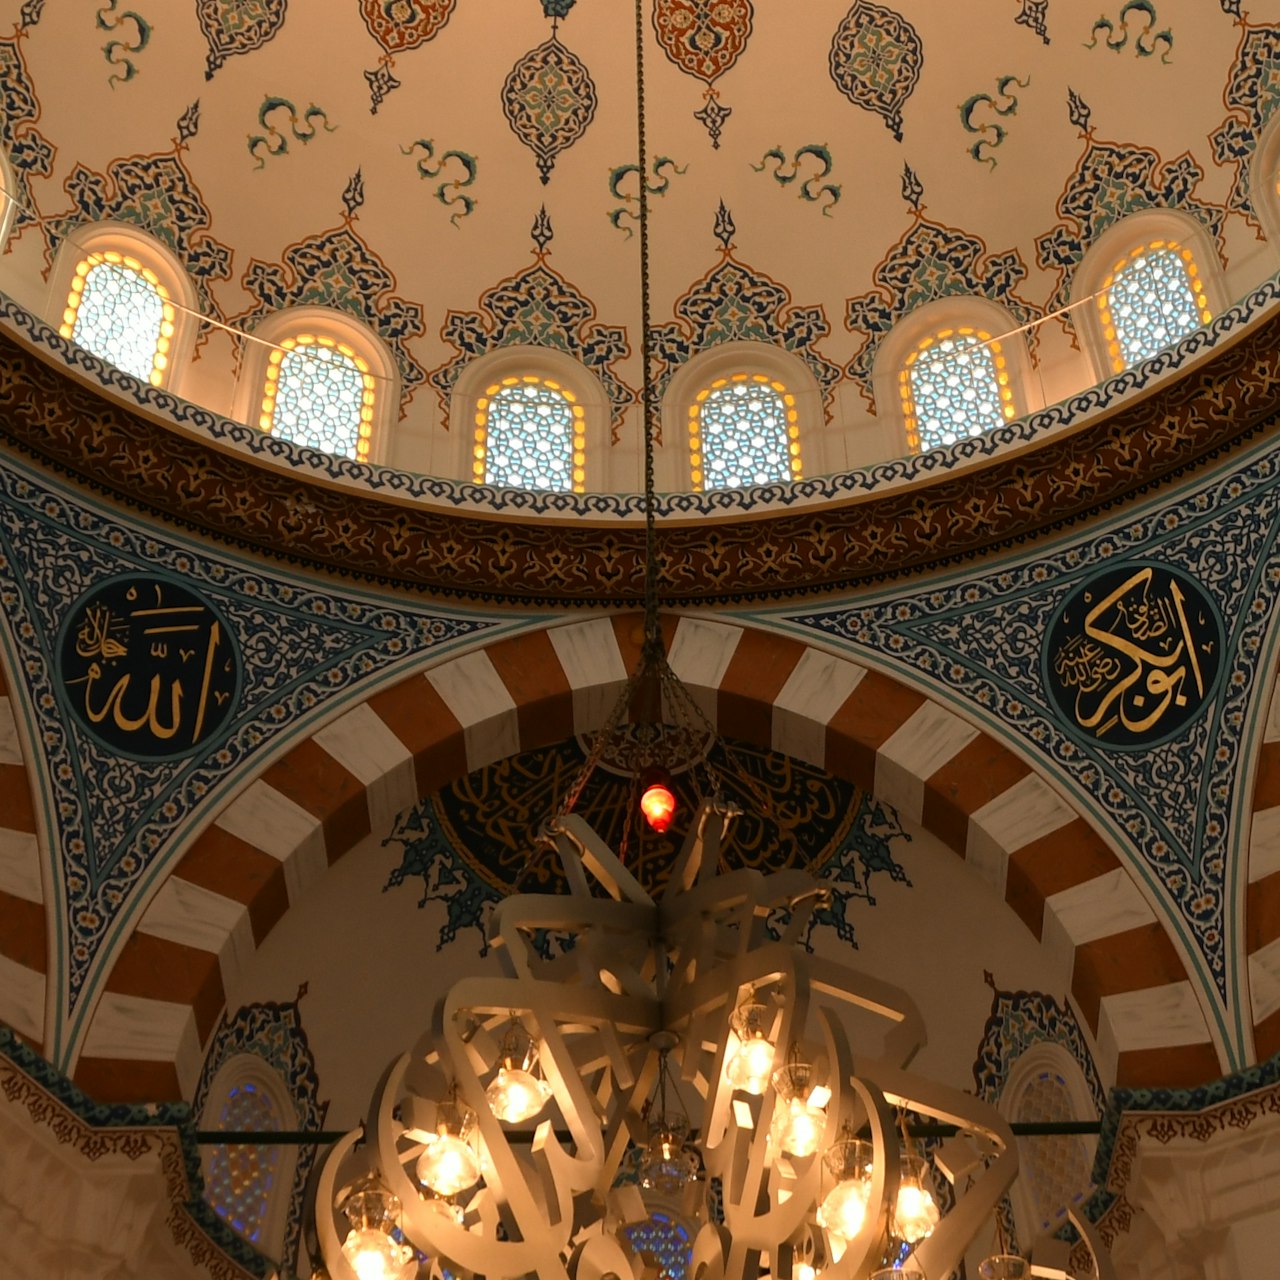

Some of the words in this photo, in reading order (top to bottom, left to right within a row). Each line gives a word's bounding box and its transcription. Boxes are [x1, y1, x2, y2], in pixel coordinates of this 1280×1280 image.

[84, 620, 220, 744] الله
[1074, 567, 1188, 728] بكر
[1120, 578, 1204, 734] ابو
